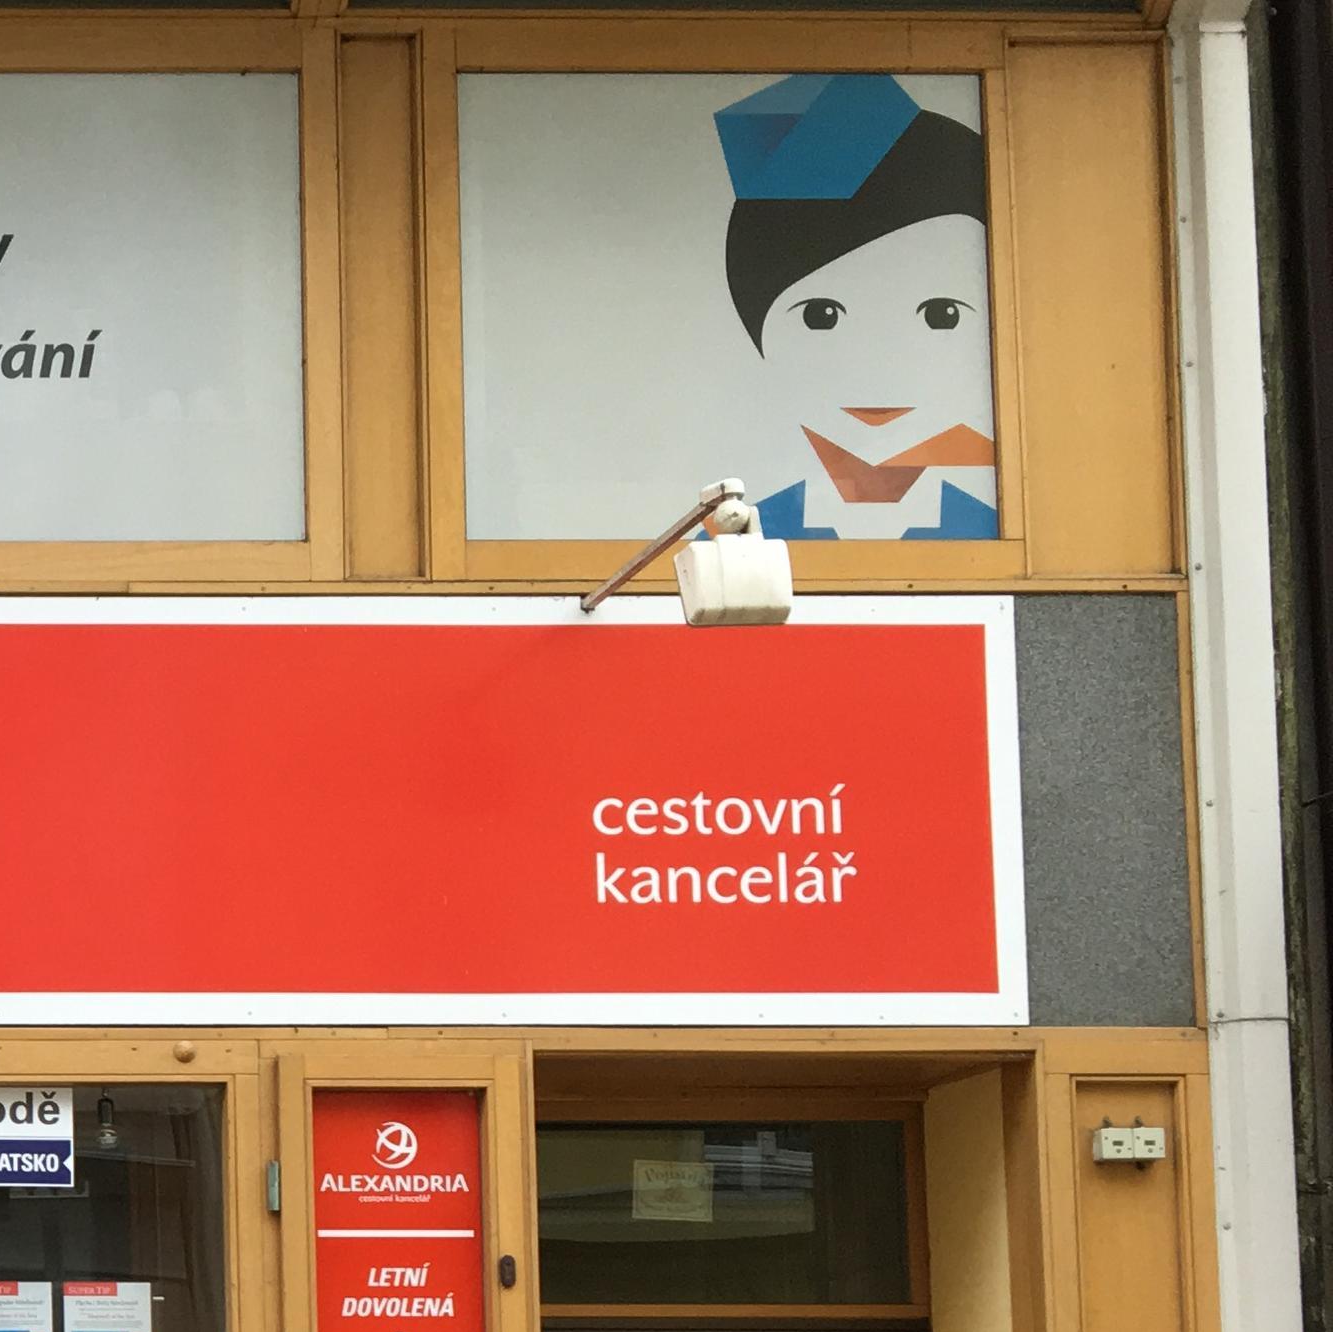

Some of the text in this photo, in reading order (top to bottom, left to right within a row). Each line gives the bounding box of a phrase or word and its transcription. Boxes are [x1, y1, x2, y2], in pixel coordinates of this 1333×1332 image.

[593, 784, 845, 835] cestovní
[597, 852, 857, 903] kancelář
[321, 1174, 469, 1192] ALEXANDRIA
[368, 1263, 429, 1286] LETNÍ
[342, 1293, 453, 1317] DOVOLENÁ
